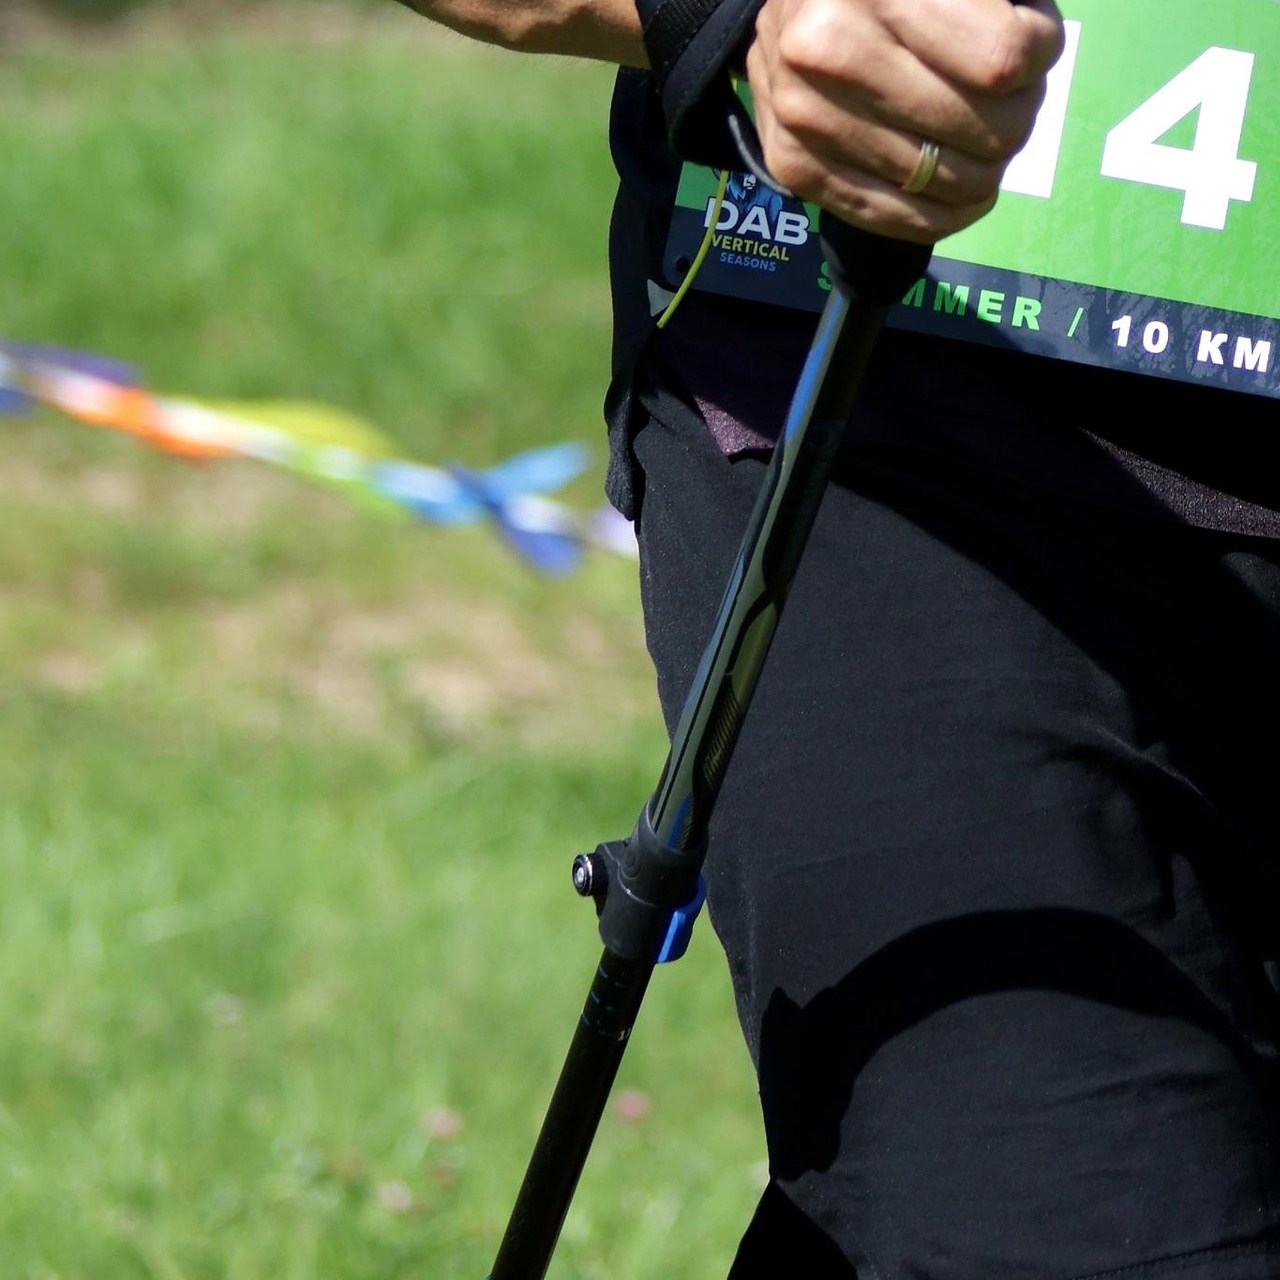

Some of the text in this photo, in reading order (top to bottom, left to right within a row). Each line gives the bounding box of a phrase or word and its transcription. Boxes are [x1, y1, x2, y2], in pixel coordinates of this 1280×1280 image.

[703, 197, 810, 246] DAB
[711, 233, 790, 262] VERTICAL
[719, 251, 777, 272] SEASONS
[1111, 315, 1170, 355] 10
[1196, 329, 1272, 373] KM
